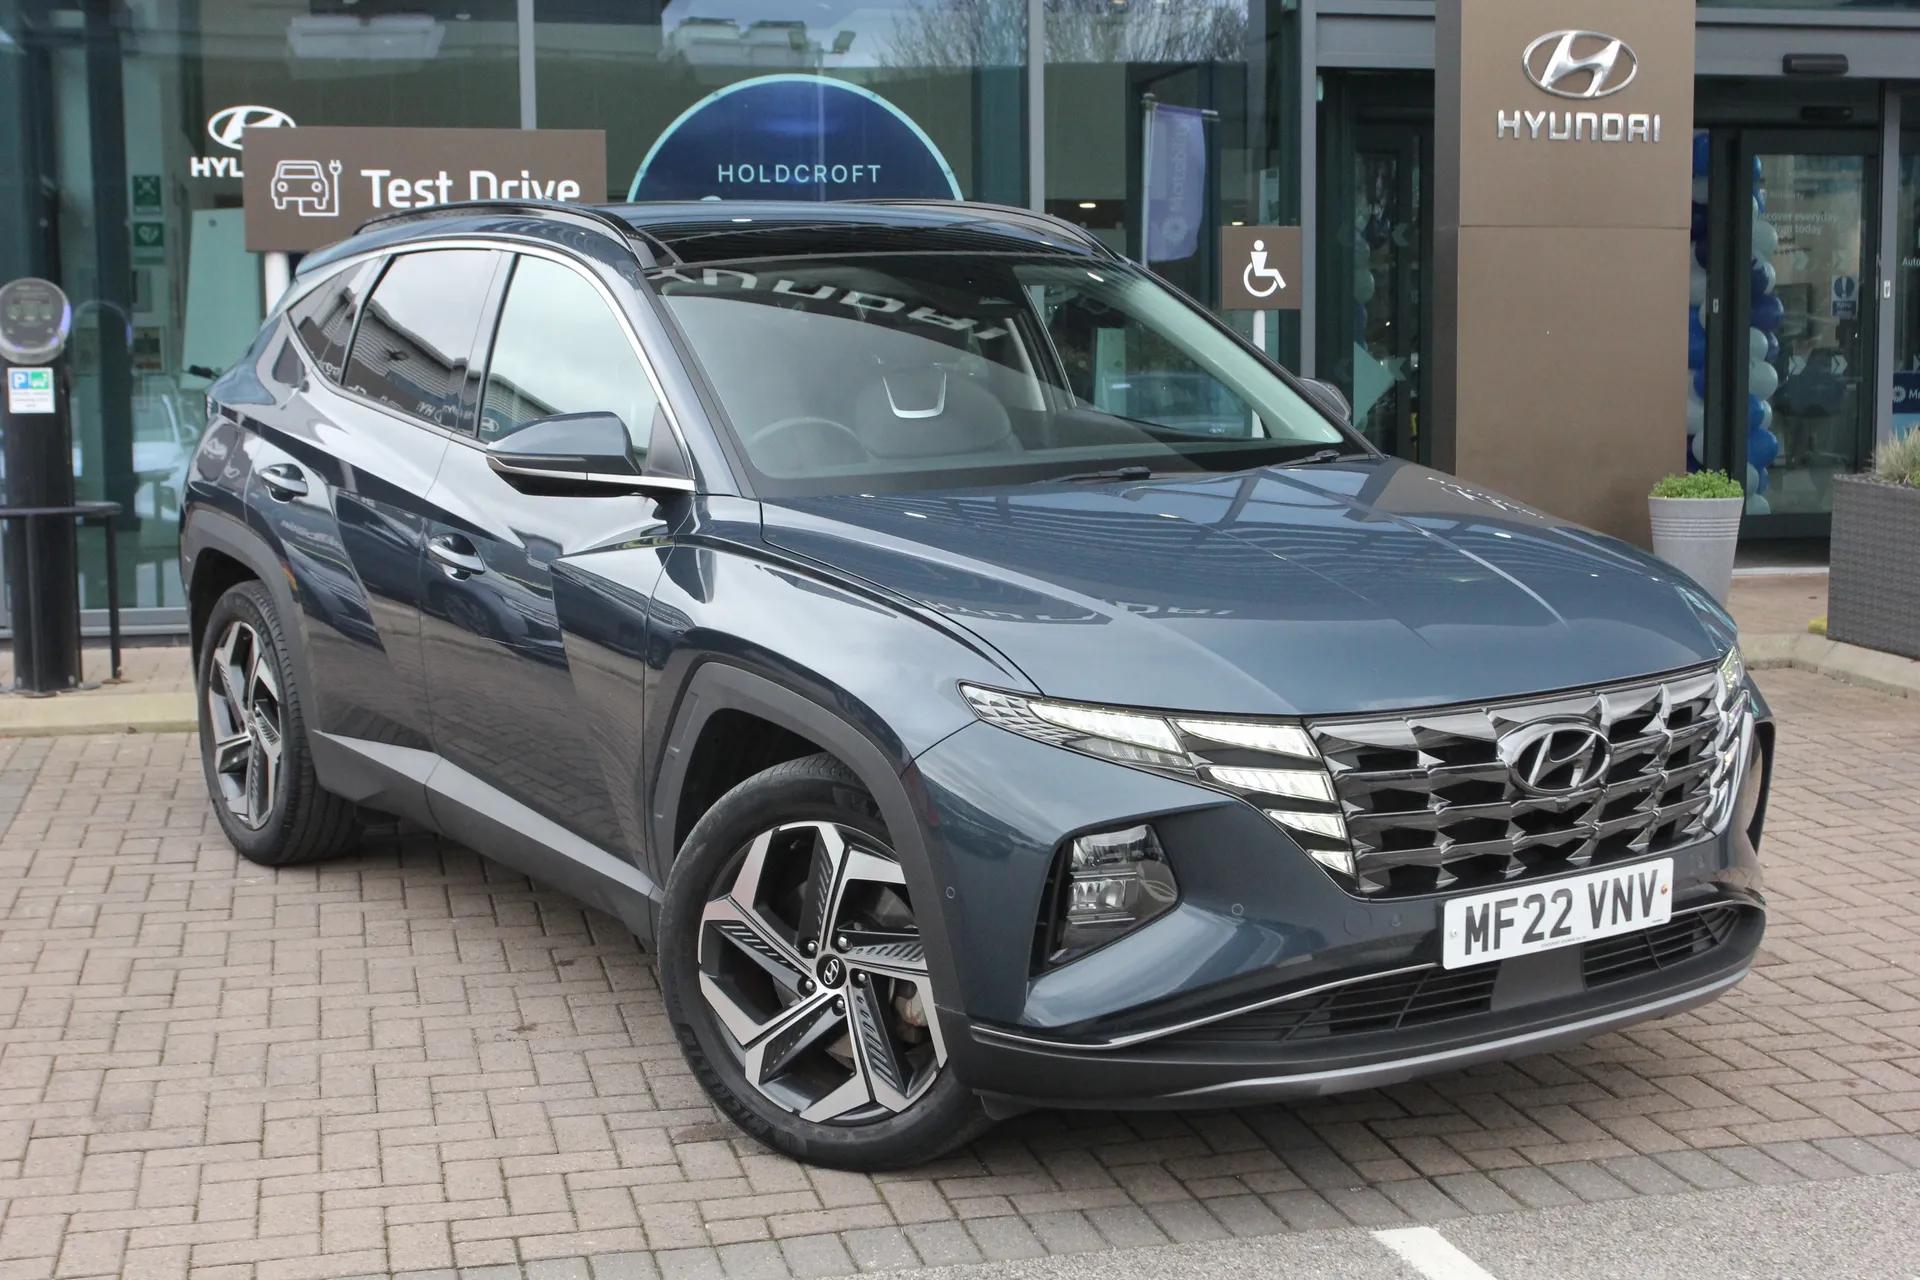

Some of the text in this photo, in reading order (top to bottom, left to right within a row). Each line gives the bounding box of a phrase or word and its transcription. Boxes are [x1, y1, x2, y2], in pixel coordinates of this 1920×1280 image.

[1497, 109, 1661, 142] HYUNDAI
[360, 169, 580, 208] Test Drive
[718, 164, 881, 183] HOLDCROFT
[1464, 869, 1658, 956] MF22 VNV
